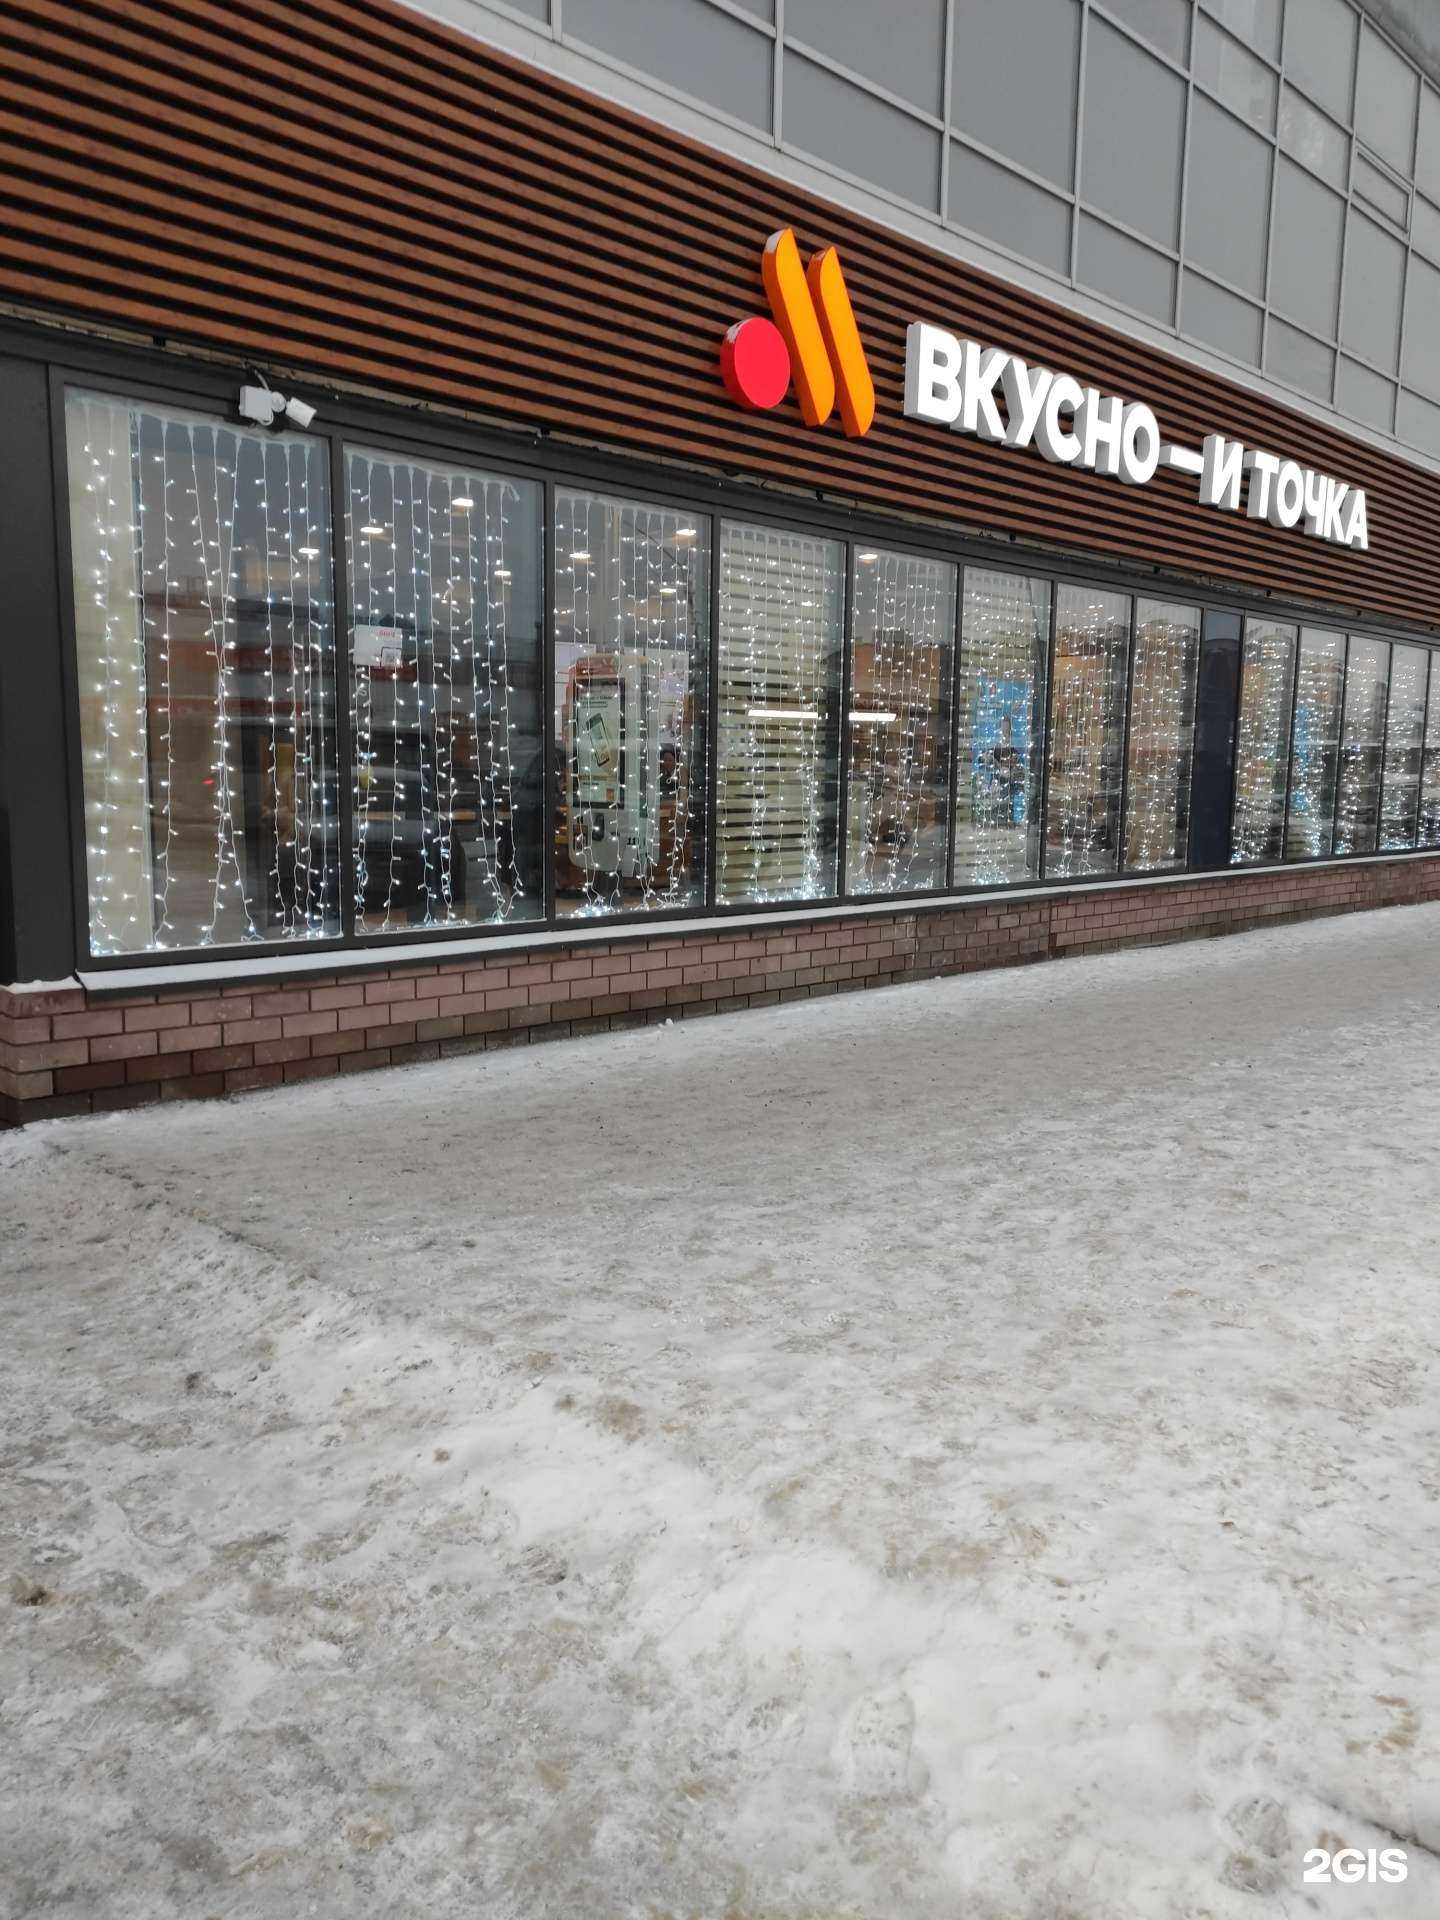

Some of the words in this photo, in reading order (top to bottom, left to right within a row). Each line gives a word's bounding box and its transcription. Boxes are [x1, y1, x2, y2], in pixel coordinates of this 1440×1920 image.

[904, 321, 1160, 485] ВКУСНО
[1199, 433, 1244, 511] И
[1247, 450, 1369, 550] ТОЧКА
